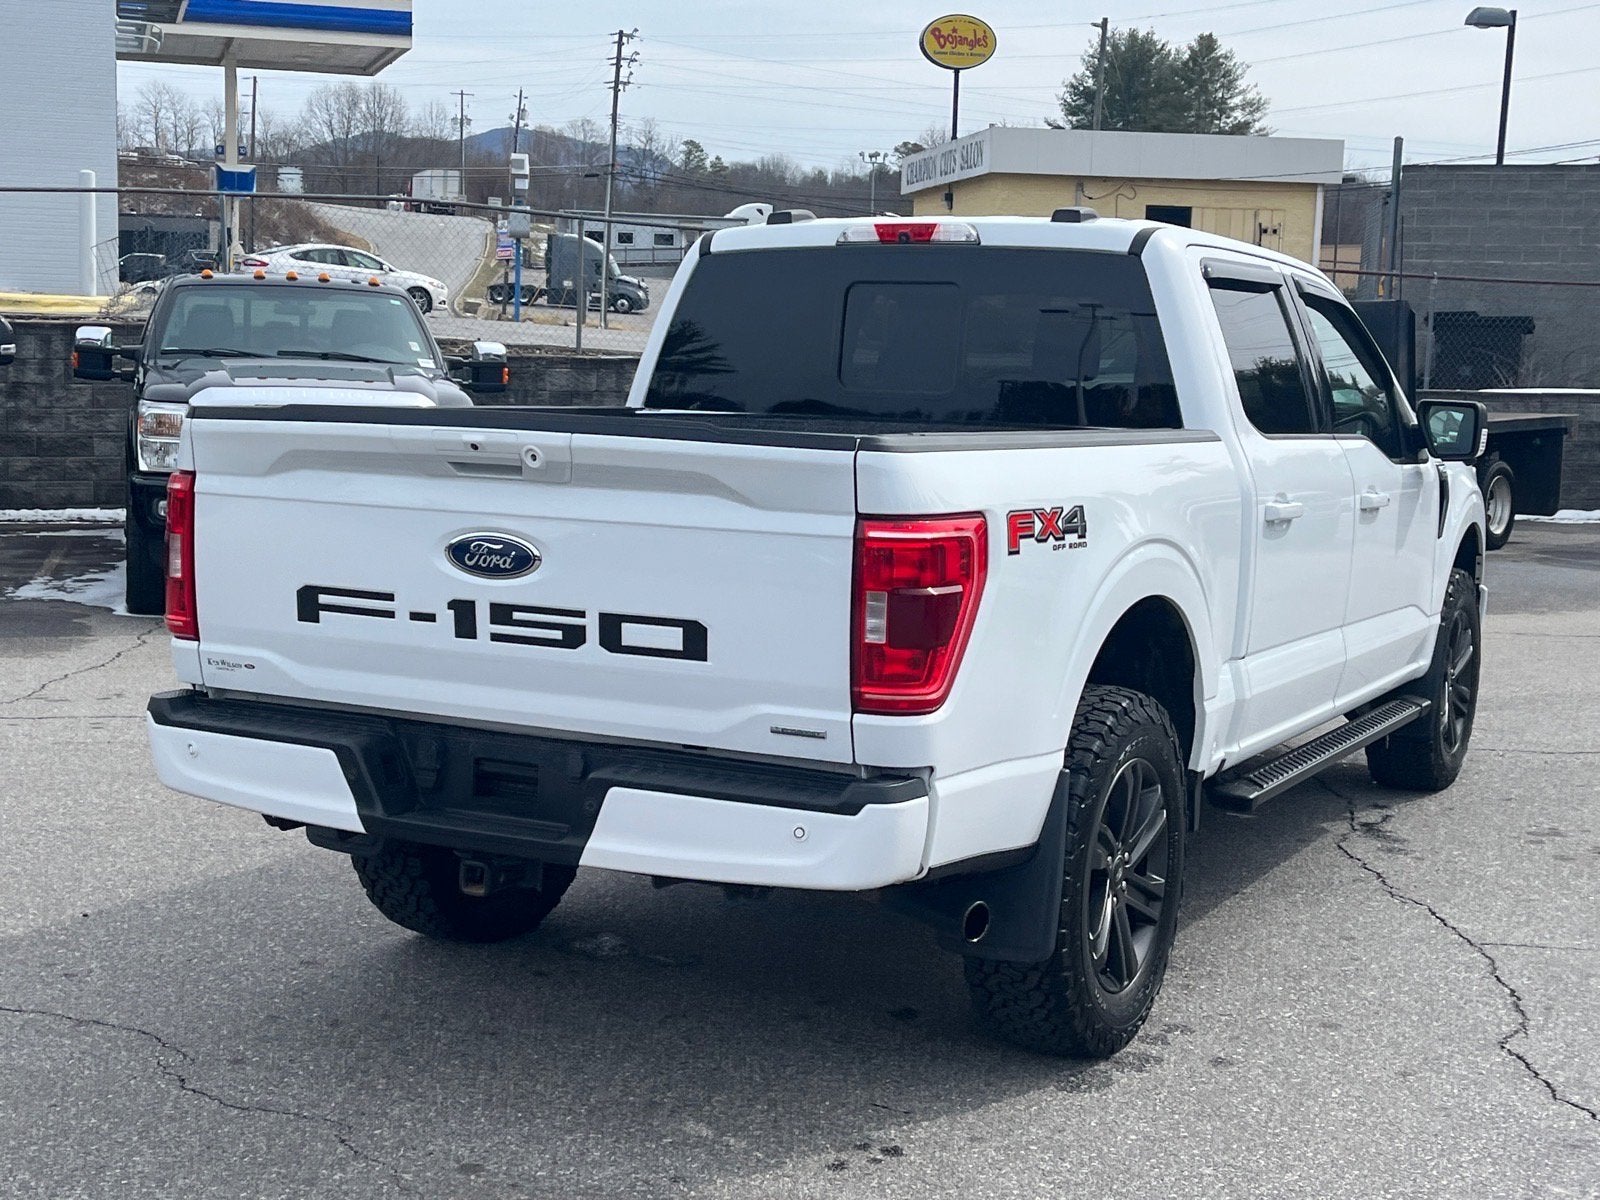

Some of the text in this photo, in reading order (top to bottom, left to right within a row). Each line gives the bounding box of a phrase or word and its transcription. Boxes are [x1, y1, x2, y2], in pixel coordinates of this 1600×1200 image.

[940, 149, 957, 177] CUTS
[960, 140, 984, 171] SALON
[1006, 505, 1087, 556] FX4
[1053, 541, 1087, 551] OFF ROAD
[464, 541, 516, 569] Ford
[297, 585, 708, 662] F-150
